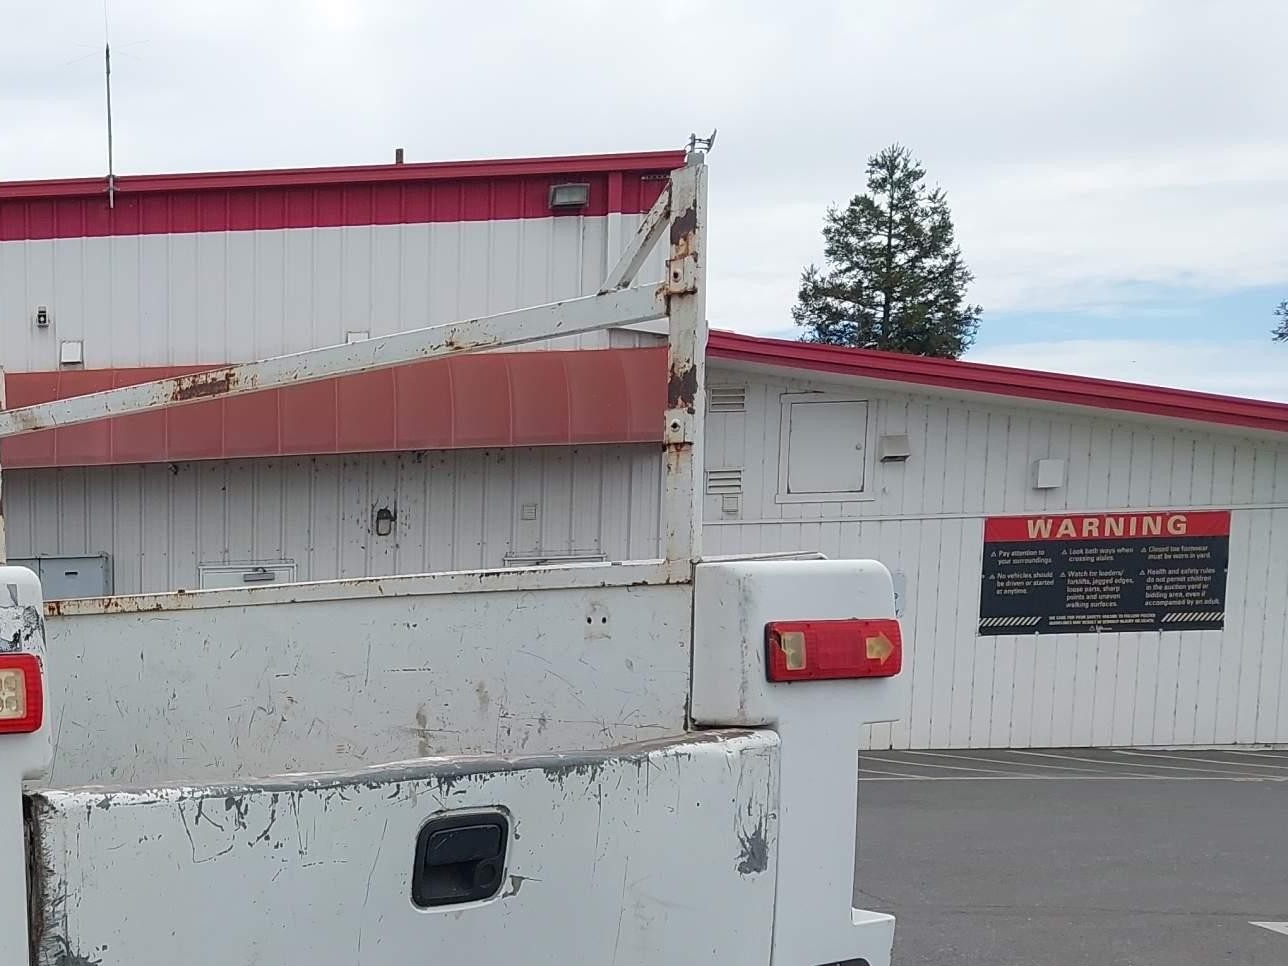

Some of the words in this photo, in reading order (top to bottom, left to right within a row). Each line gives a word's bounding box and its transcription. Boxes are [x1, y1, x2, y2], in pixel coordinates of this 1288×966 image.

[1027, 515, 1187, 538] WARNING
[1092, 578, 1113, 586] jagged
[1103, 585, 1120, 593] sharp
